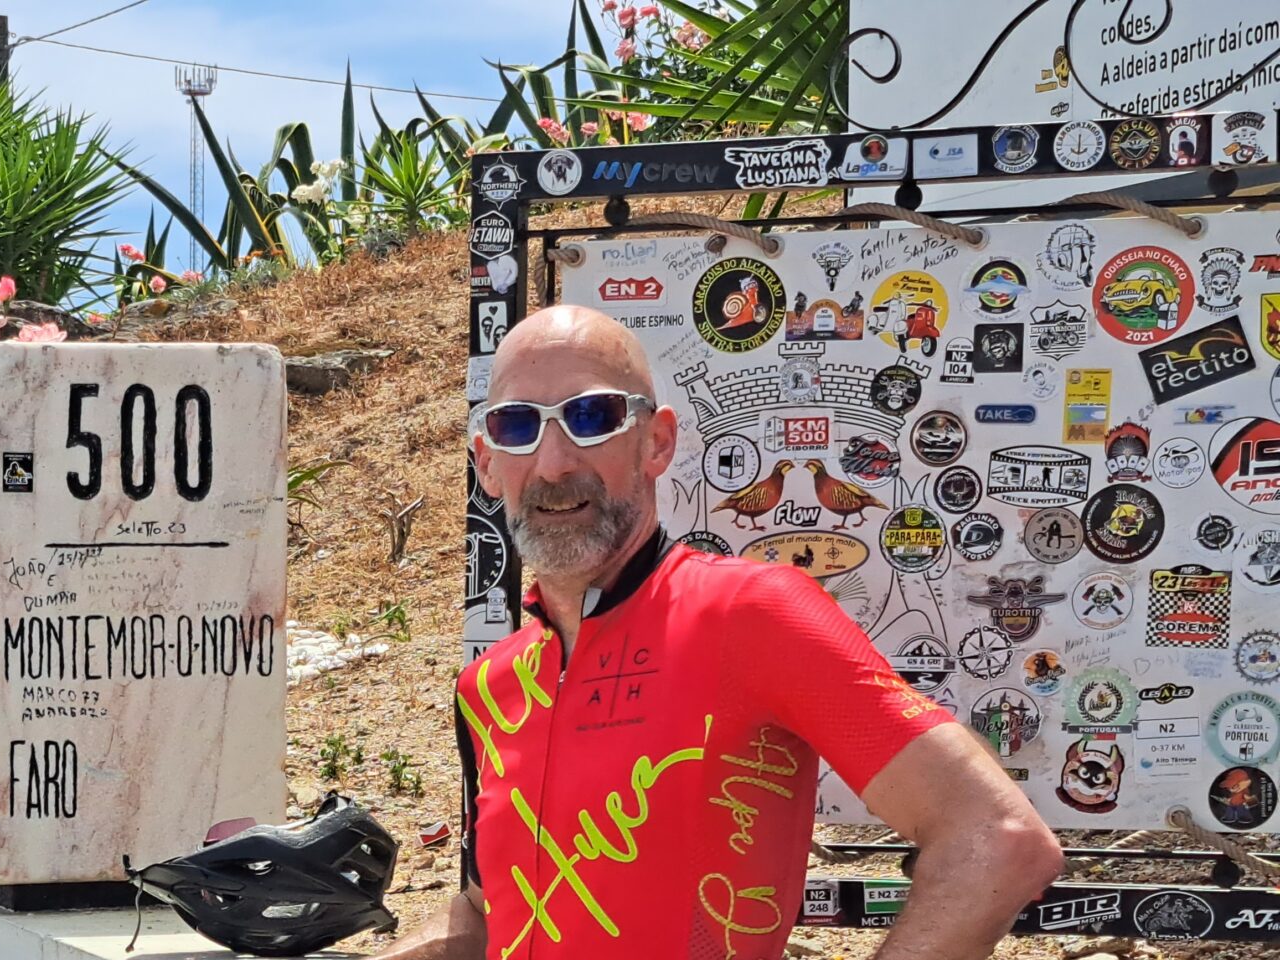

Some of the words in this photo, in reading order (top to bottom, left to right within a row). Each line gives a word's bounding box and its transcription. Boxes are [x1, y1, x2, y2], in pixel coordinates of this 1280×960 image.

[1101, 62, 1111, 87] A
[1113, 50, 1157, 84] aldeia
[1160, 52, 1168, 70] a
[1172, 34, 1216, 73] partir
[1219, 22, 1243, 54] daí
[742, 149, 818, 168] TAVERNA
[846, 160, 887, 176] Lagoa
[746, 166, 821, 185] LUSITANA
[480, 181, 520, 192] NORTHERN
[481, 219, 505, 227] EURO
[1103, 251, 1144, 280] ODISSEIA
[1145, 250, 1161, 260] NO
[1161, 253, 1188, 281] CHAÇO
[723, 258, 737, 272] DO
[739, 257, 783, 298] ALCATRÃO
[605, 283, 636, 297] EN
[643, 281, 657, 296] 2
[648, 313, 684, 328] ESPINHO
[1125, 330, 1155, 342] 2021
[951, 351, 968, 362] N2
[949, 363, 968, 375] 104
[1151, 352, 1176, 378] el
[978, 409, 1012, 421] TAKE
[787, 418, 826, 431] KM
[65, 382, 214, 502] 500
[787, 431, 826, 443] 500
[774, 501, 821, 527] Flow
[956, 514, 1000, 533] PAULINHO
[695, 532, 713, 542] DAS
[786, 536, 795, 544] al
[796, 534, 823, 543] mundo
[836, 537, 856, 548] moto
[1157, 575, 1179, 589] 23
[991, 608, 1042, 617] EUROTRIP
[1155, 622, 1221, 633] COREMA
[599, 651, 612, 669] V
[633, 648, 649, 665] C
[586, 687, 602, 706] A
[626, 683, 641, 702] H
[1141, 690, 1161, 699] LES
[1171, 687, 1191, 697] LES
[1159, 723, 1176, 733] N2
[1225, 731, 1269, 742] PORTUGAL
[1151, 745, 1170, 753] 0-37
[1171, 743, 1186, 751] KM
[9, 739, 78, 820] FARO
[809, 890, 826, 900] N2
[878, 890, 892, 899] N2
[808, 903, 829, 913] 248
